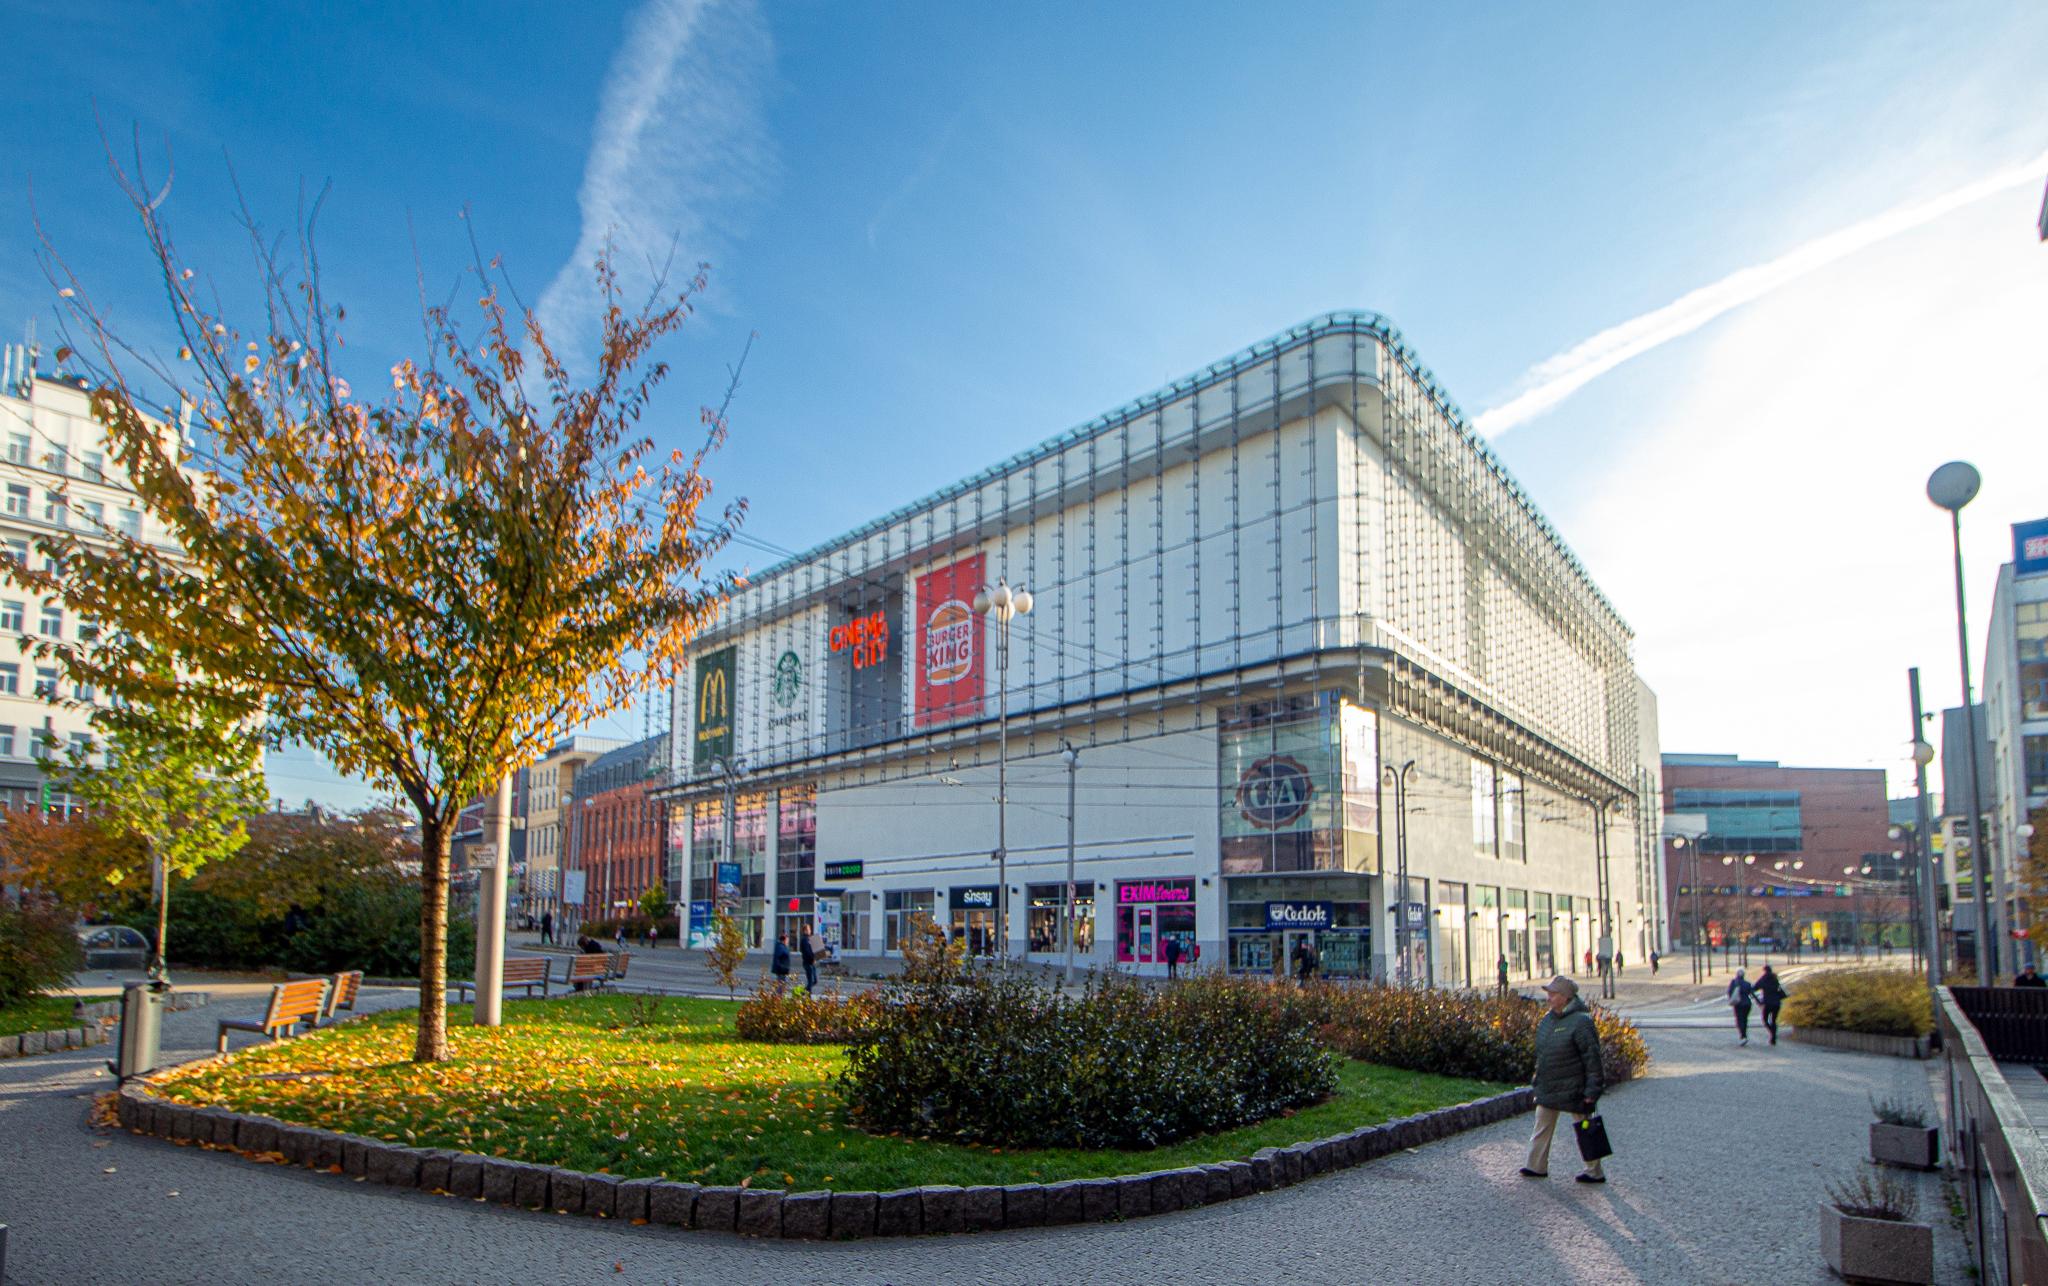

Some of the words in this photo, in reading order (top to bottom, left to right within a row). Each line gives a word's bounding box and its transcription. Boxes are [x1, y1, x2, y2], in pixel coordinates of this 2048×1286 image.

[829, 610, 889, 652] CINEMA
[930, 623, 969, 647] BURGER
[853, 641, 887, 671] CITY
[930, 640, 969, 668] KING
[1250, 776, 1297, 809] C&A
[963, 889, 992, 907] sinsay
